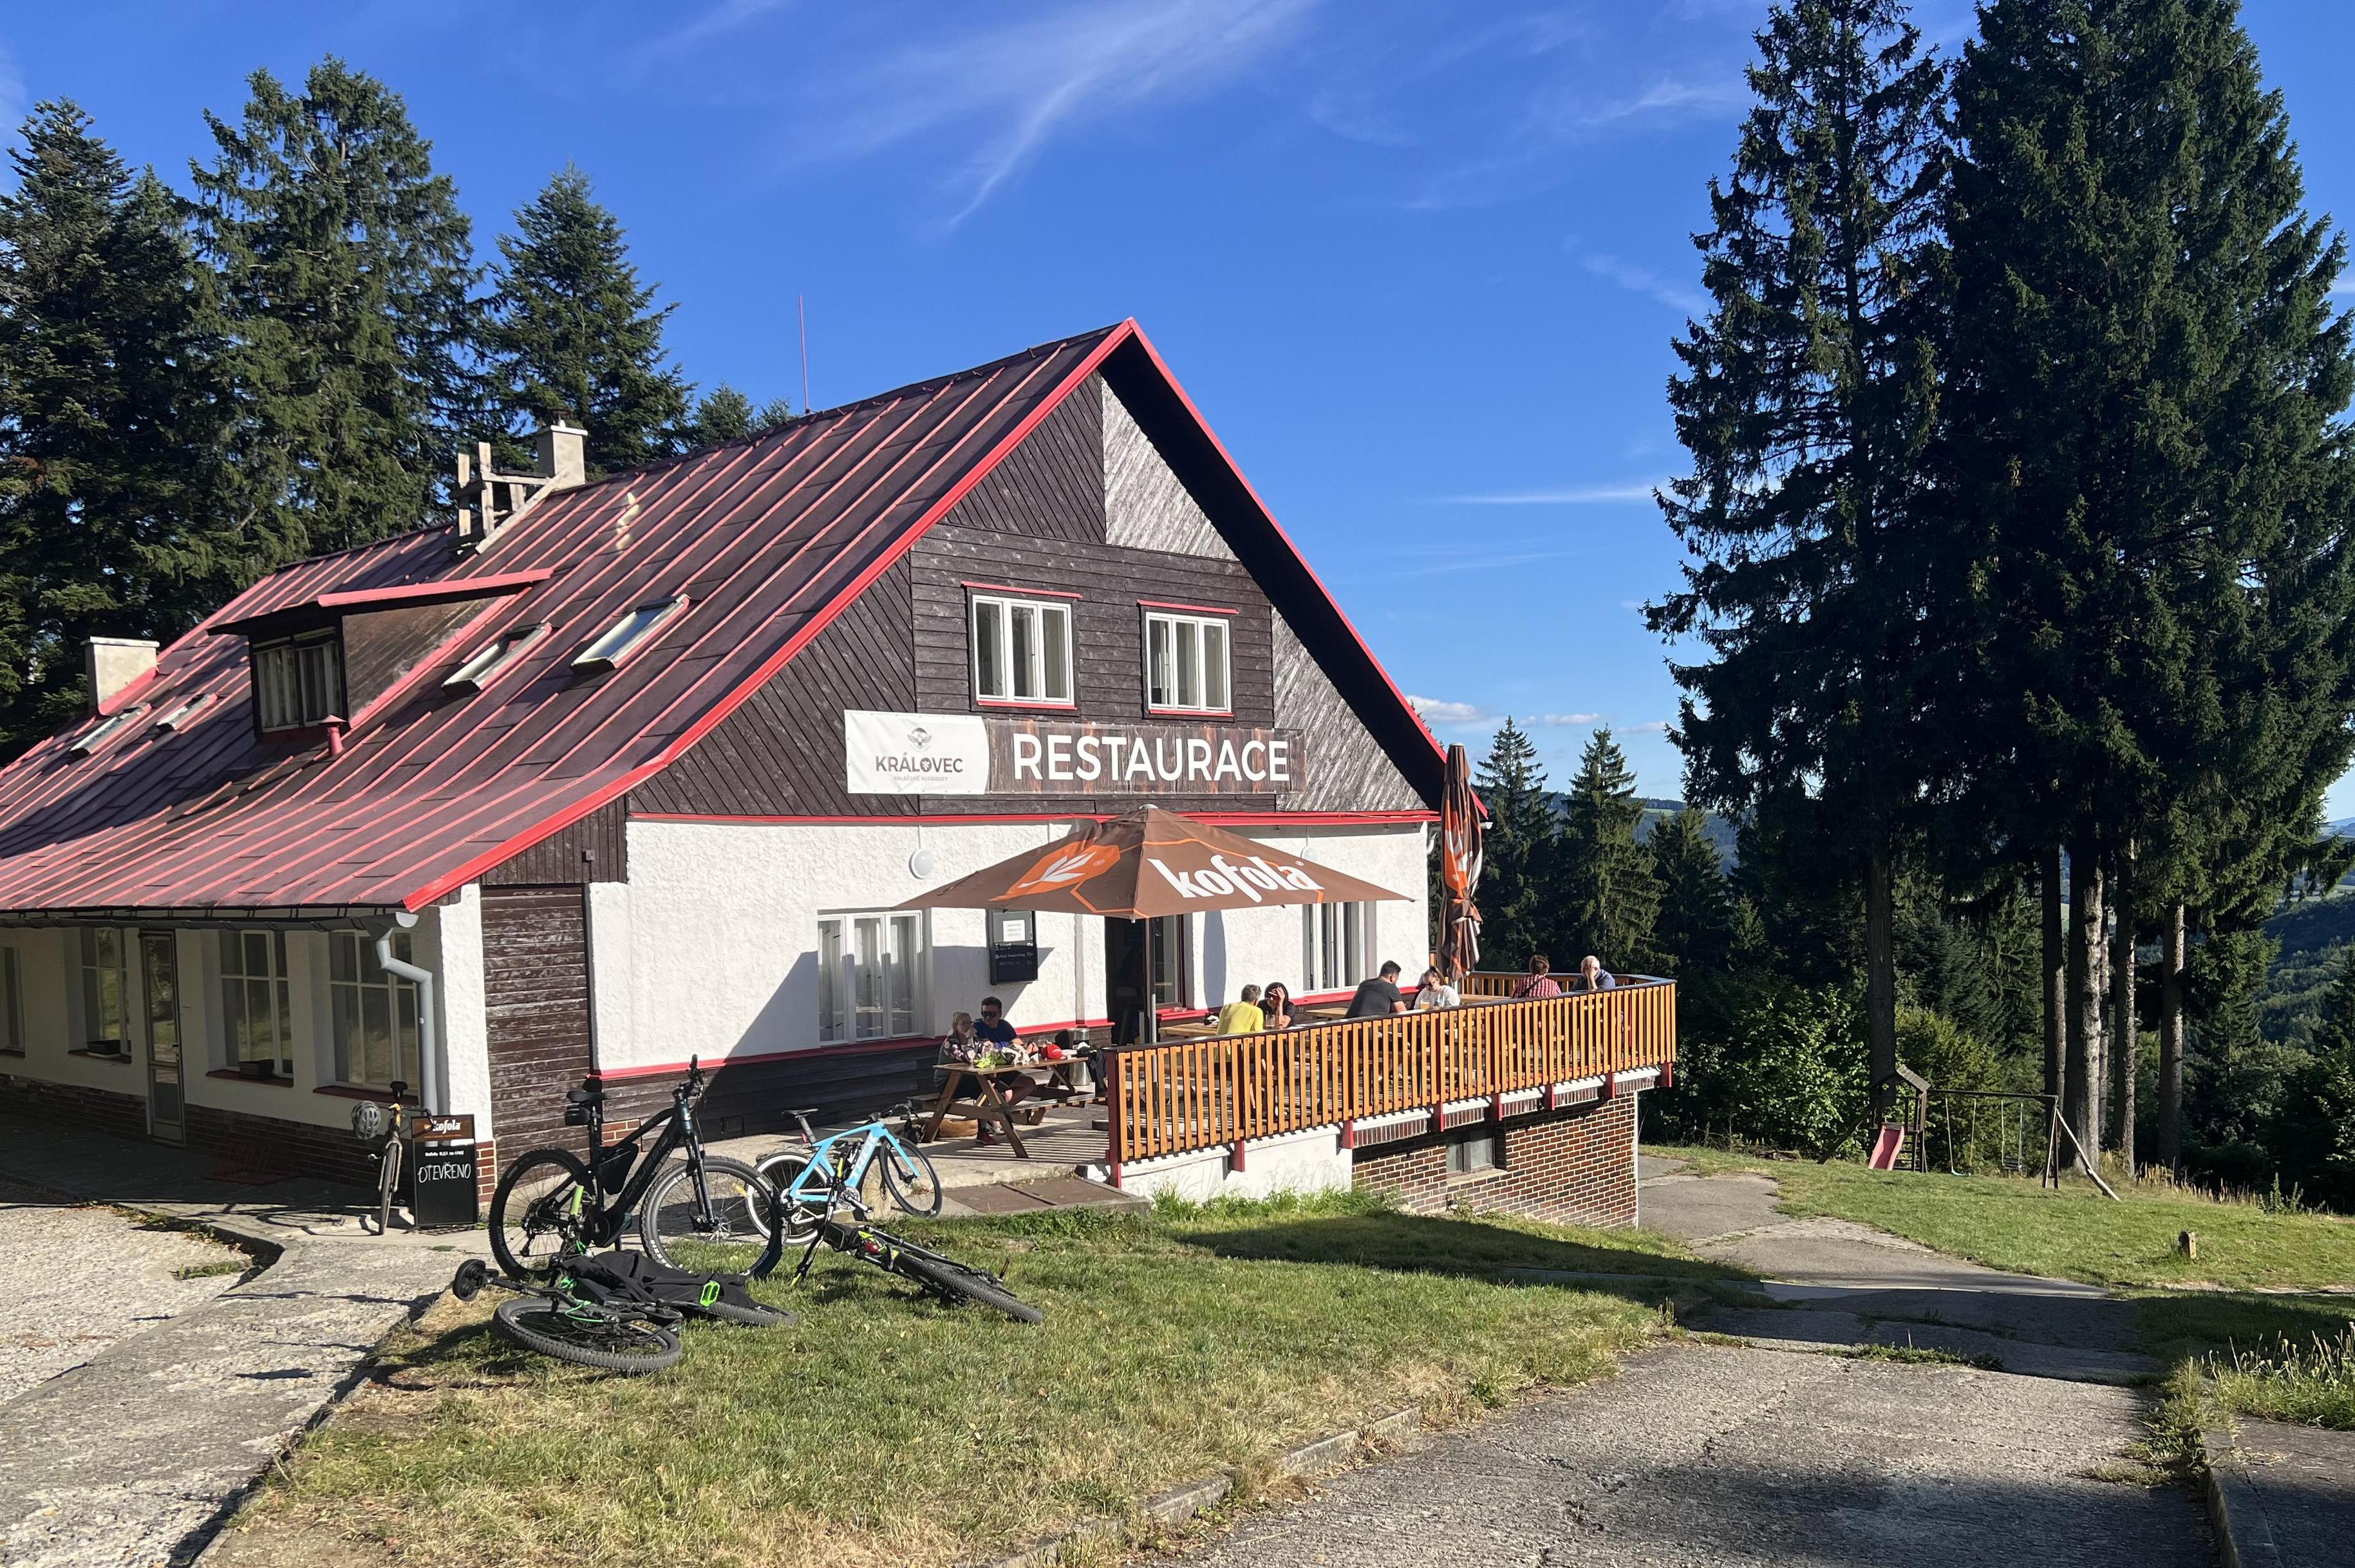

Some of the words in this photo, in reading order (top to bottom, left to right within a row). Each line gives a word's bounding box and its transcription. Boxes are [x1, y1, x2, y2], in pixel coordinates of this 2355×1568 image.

[875, 752, 963, 773] KRÁLOVEC
[1013, 733, 1290, 782] RESTAURACE
[1147, 854, 1324, 903] kofola
[417, 1162, 472, 1183] OTEVŘENO
